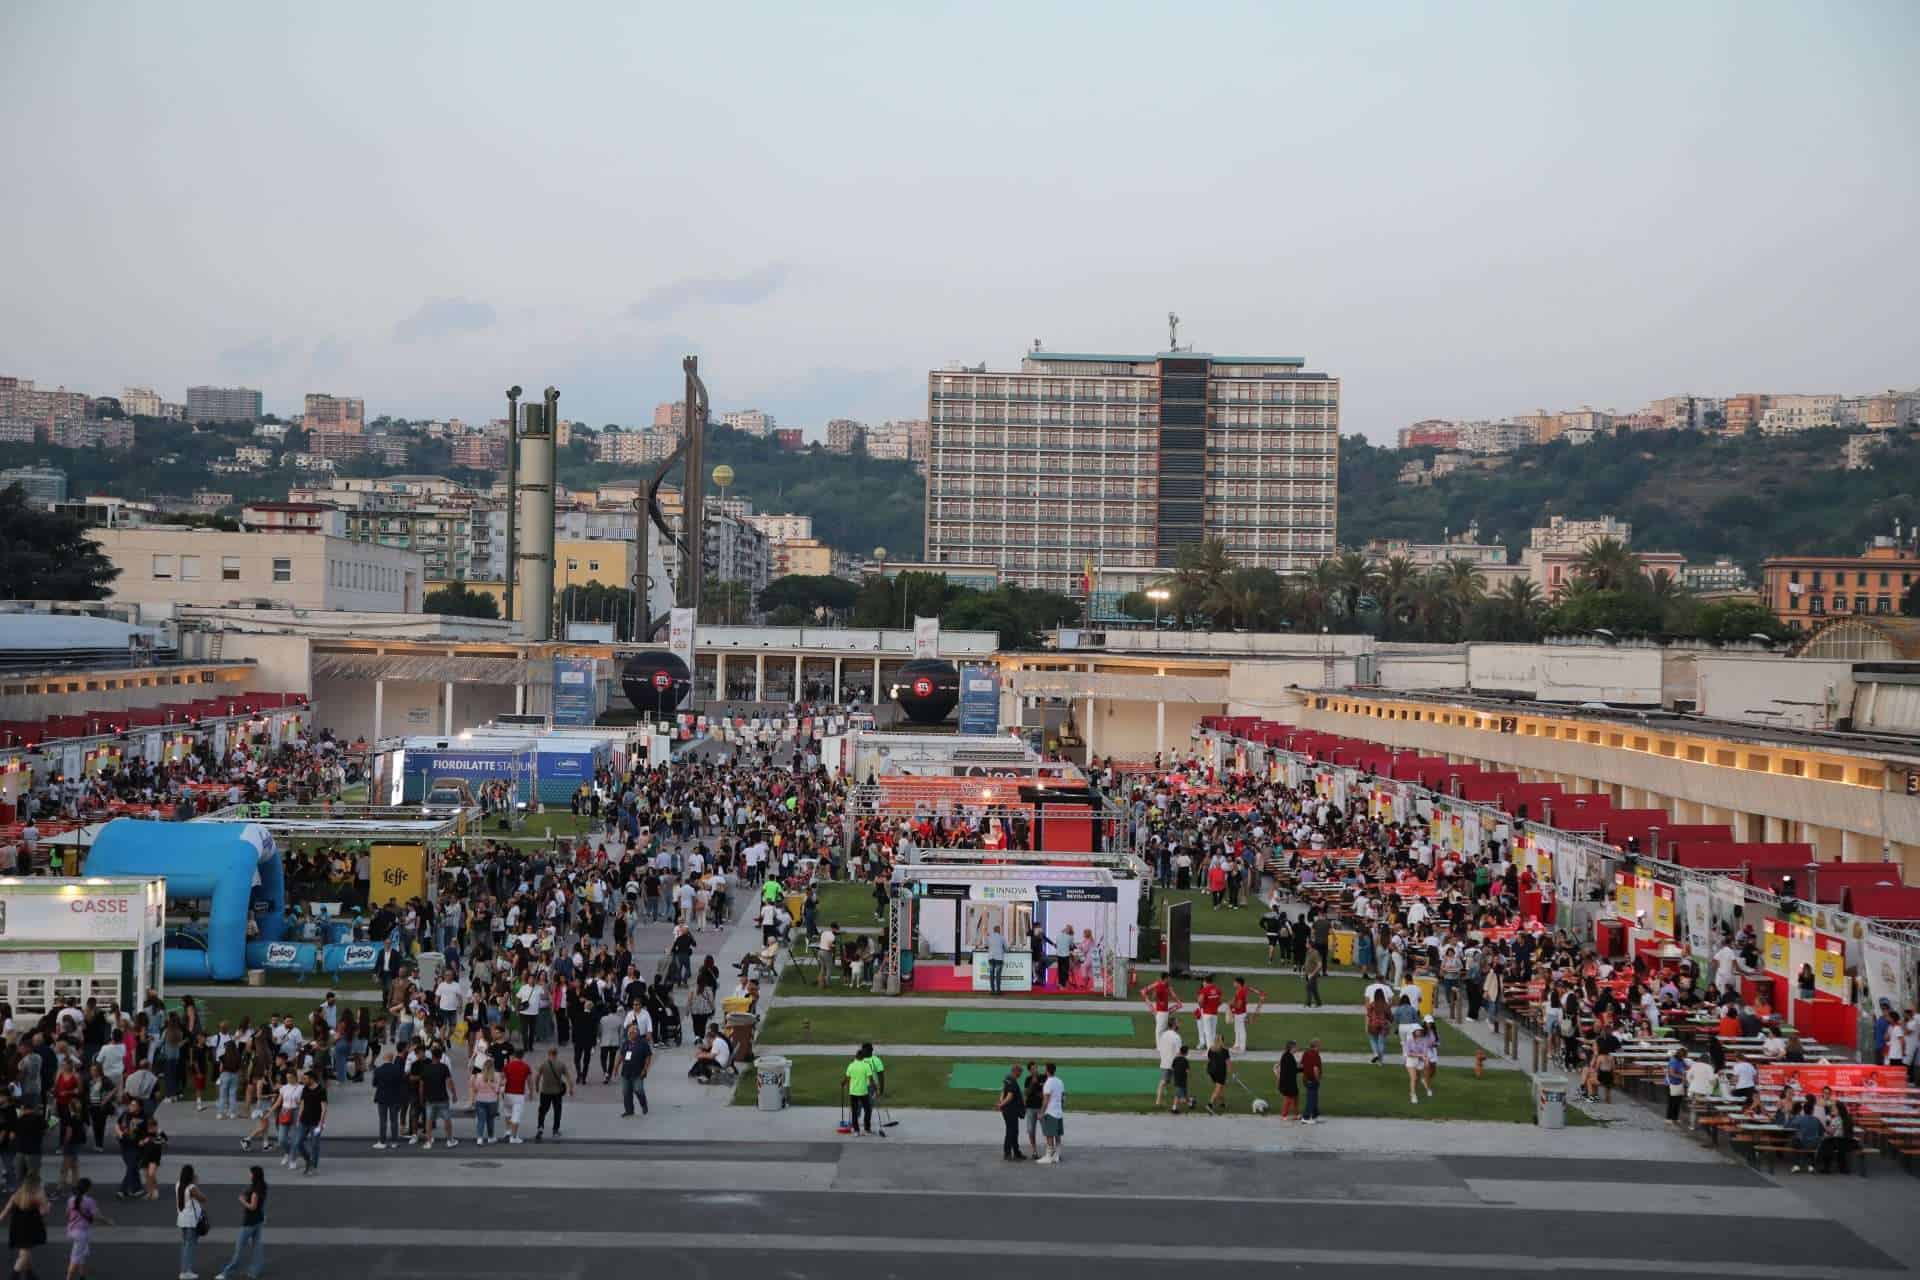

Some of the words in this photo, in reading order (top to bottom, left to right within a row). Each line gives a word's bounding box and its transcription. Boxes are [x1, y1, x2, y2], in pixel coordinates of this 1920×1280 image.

[1505, 719, 1513, 730] 2
[433, 760, 496, 770] FIORDILATTE
[1909, 775, 1919, 791] 3
[71, 899, 129, 912] CASSE
